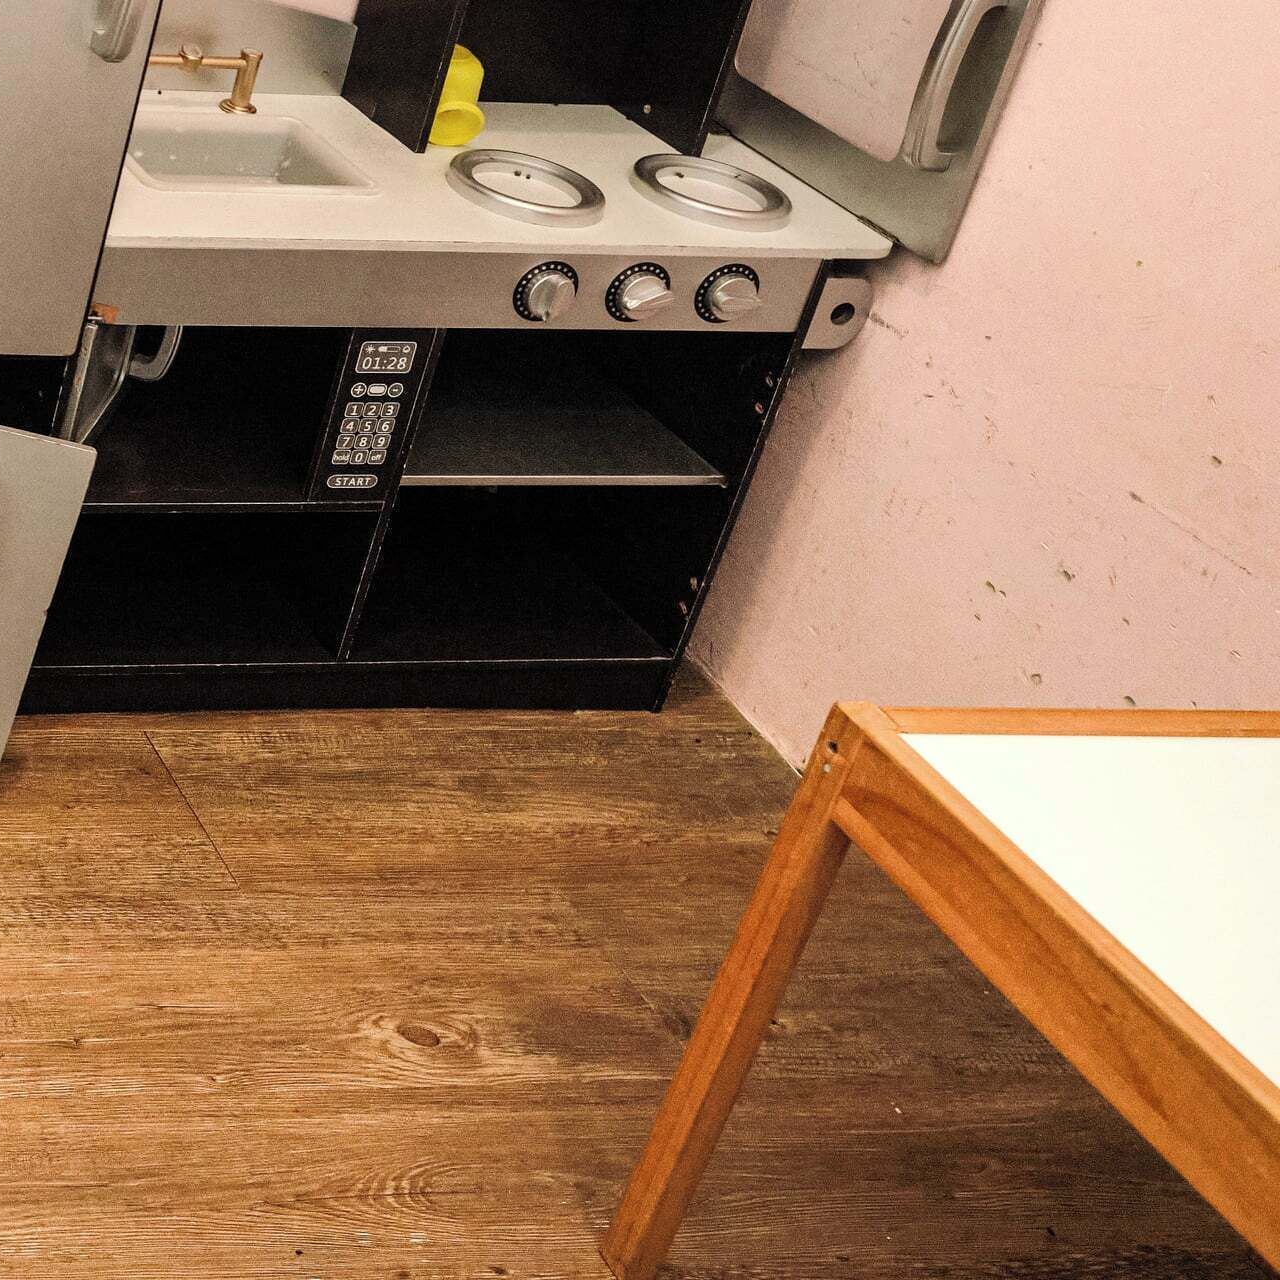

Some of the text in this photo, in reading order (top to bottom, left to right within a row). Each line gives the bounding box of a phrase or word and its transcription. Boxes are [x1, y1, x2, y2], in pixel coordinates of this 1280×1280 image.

[362, 356, 408, 370] 01:28
[350, 405, 394, 416] 1 2 3
[345, 421, 390, 432] 4 5 6
[342, 437, 386, 447] 7 8 9
[354, 452, 363, 463] 0
[371, 453, 382, 461] off
[334, 477, 372, 486] START
